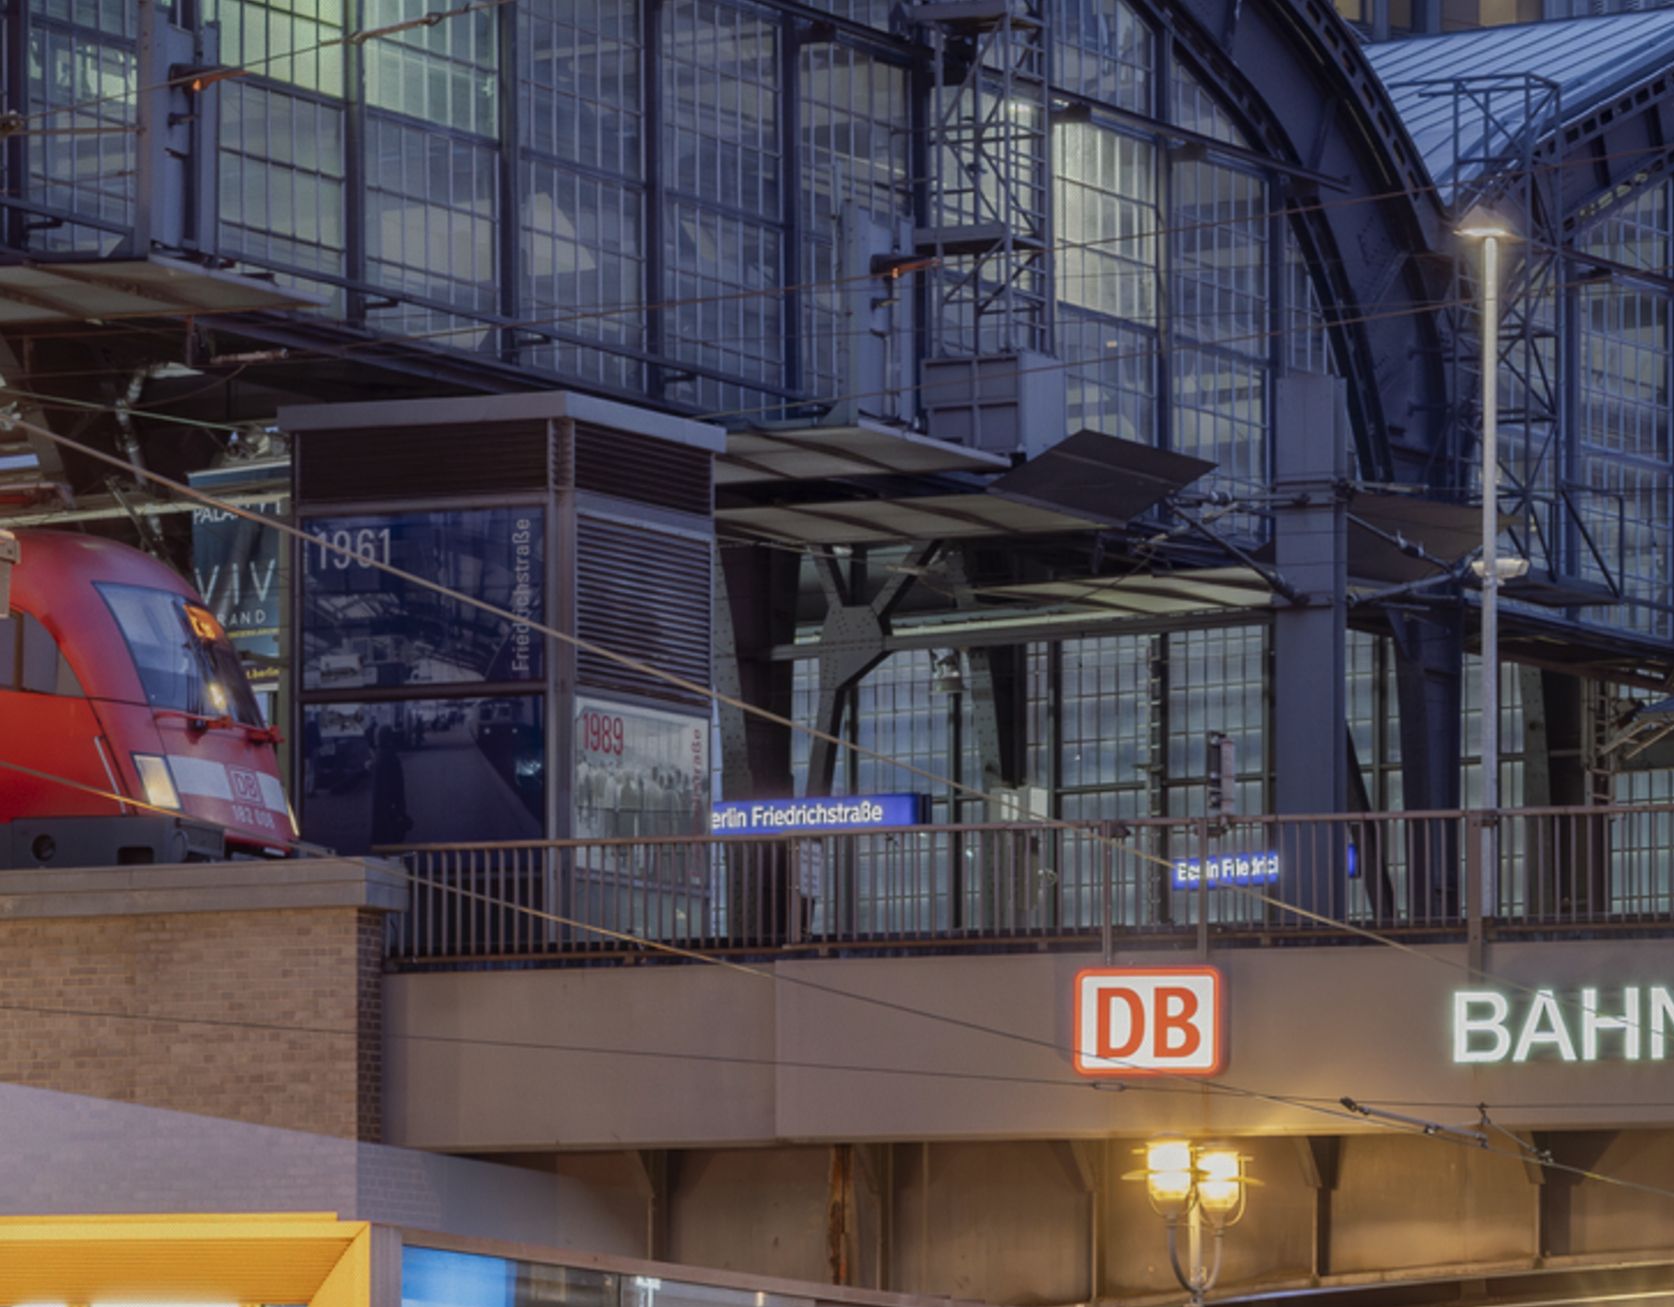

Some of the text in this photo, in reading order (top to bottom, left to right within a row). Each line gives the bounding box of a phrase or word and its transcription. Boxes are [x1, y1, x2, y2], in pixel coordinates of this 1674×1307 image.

[312, 528, 391, 570] 1961
[216, 608, 267, 627] RAND
[583, 713, 625, 756] 1989
[711, 800, 884, 829] erlin Friedrichstraße
[1095, 985, 1202, 1059] DB
